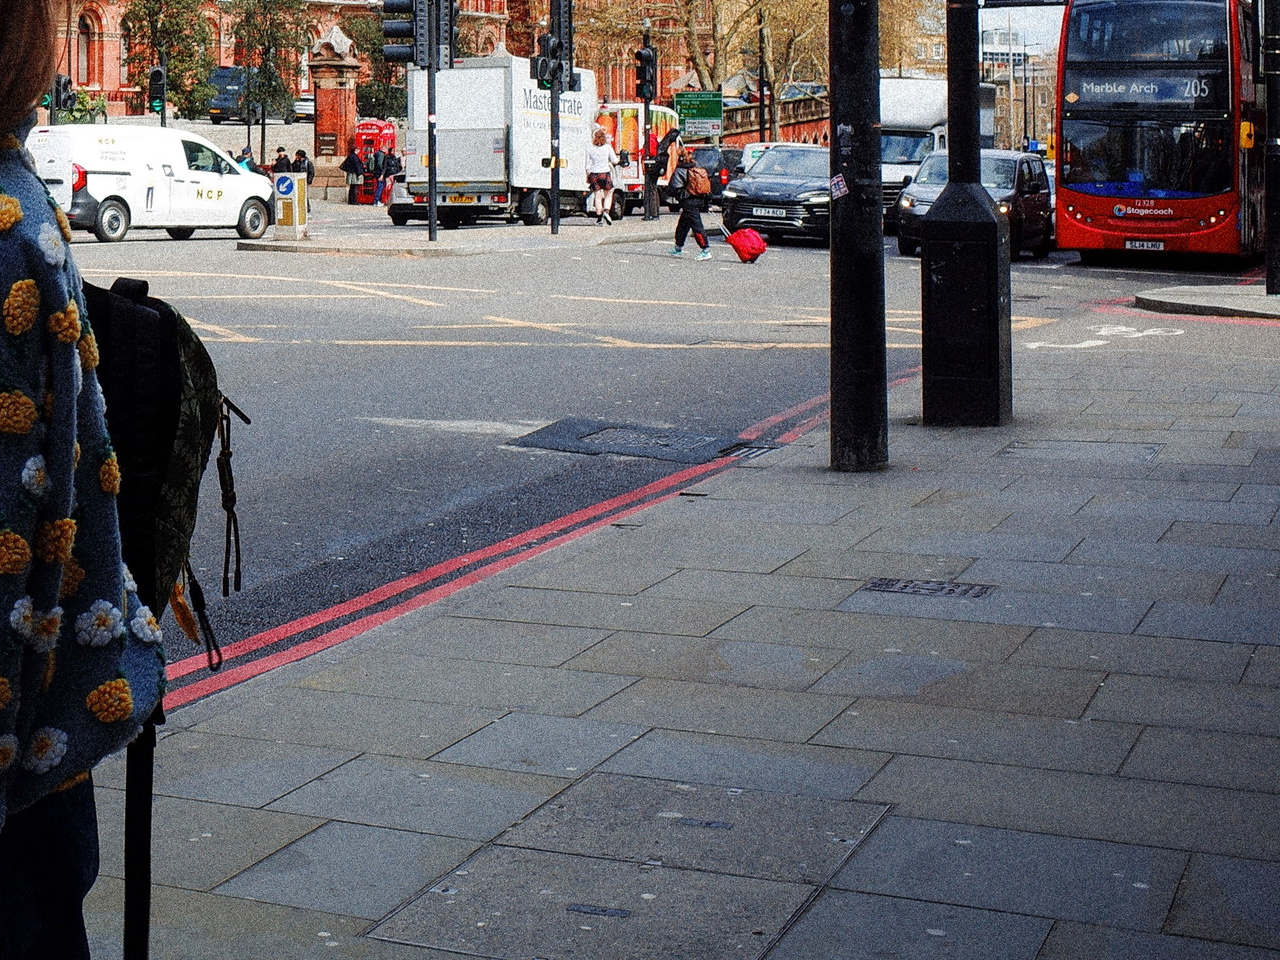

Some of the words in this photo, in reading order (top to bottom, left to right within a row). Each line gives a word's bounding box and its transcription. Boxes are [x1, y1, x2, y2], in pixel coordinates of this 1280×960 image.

[1083, 82, 1126, 95] Marble
[1129, 82, 1159, 97] Arch
[1183, 79, 1210, 98] 205
[523, 88, 582, 116] Mastecrate
[196, 189, 224, 200] NCP
[1135, 199, 1155, 207] 12328
[1126, 206, 1174, 216] Stagecoach
